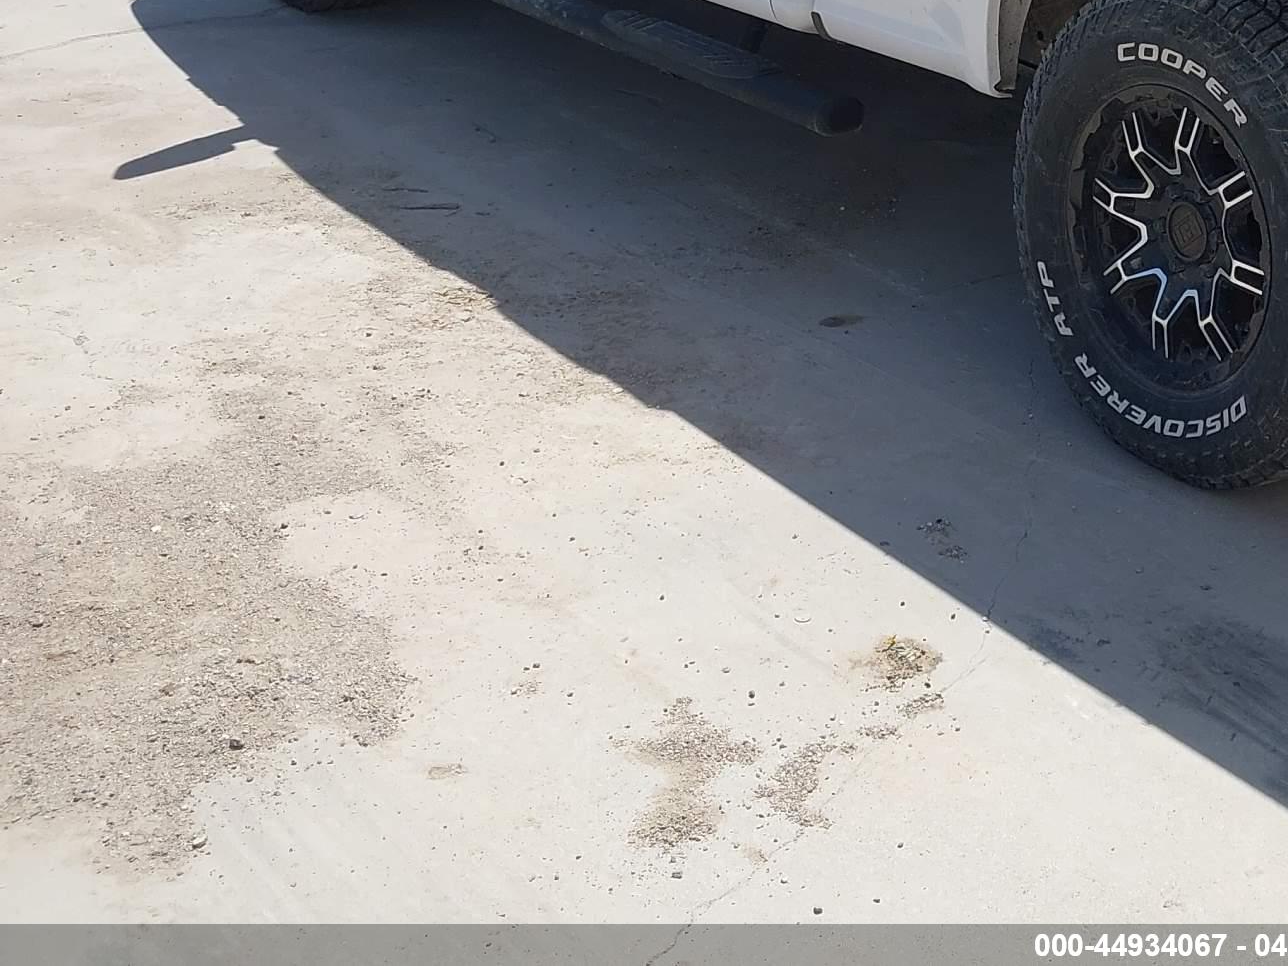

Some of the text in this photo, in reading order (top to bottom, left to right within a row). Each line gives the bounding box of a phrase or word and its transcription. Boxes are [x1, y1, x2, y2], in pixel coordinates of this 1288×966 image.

[1117, 41, 1249, 128] COOPER
[1037, 260, 1249, 439] DISCOVERER ATP
